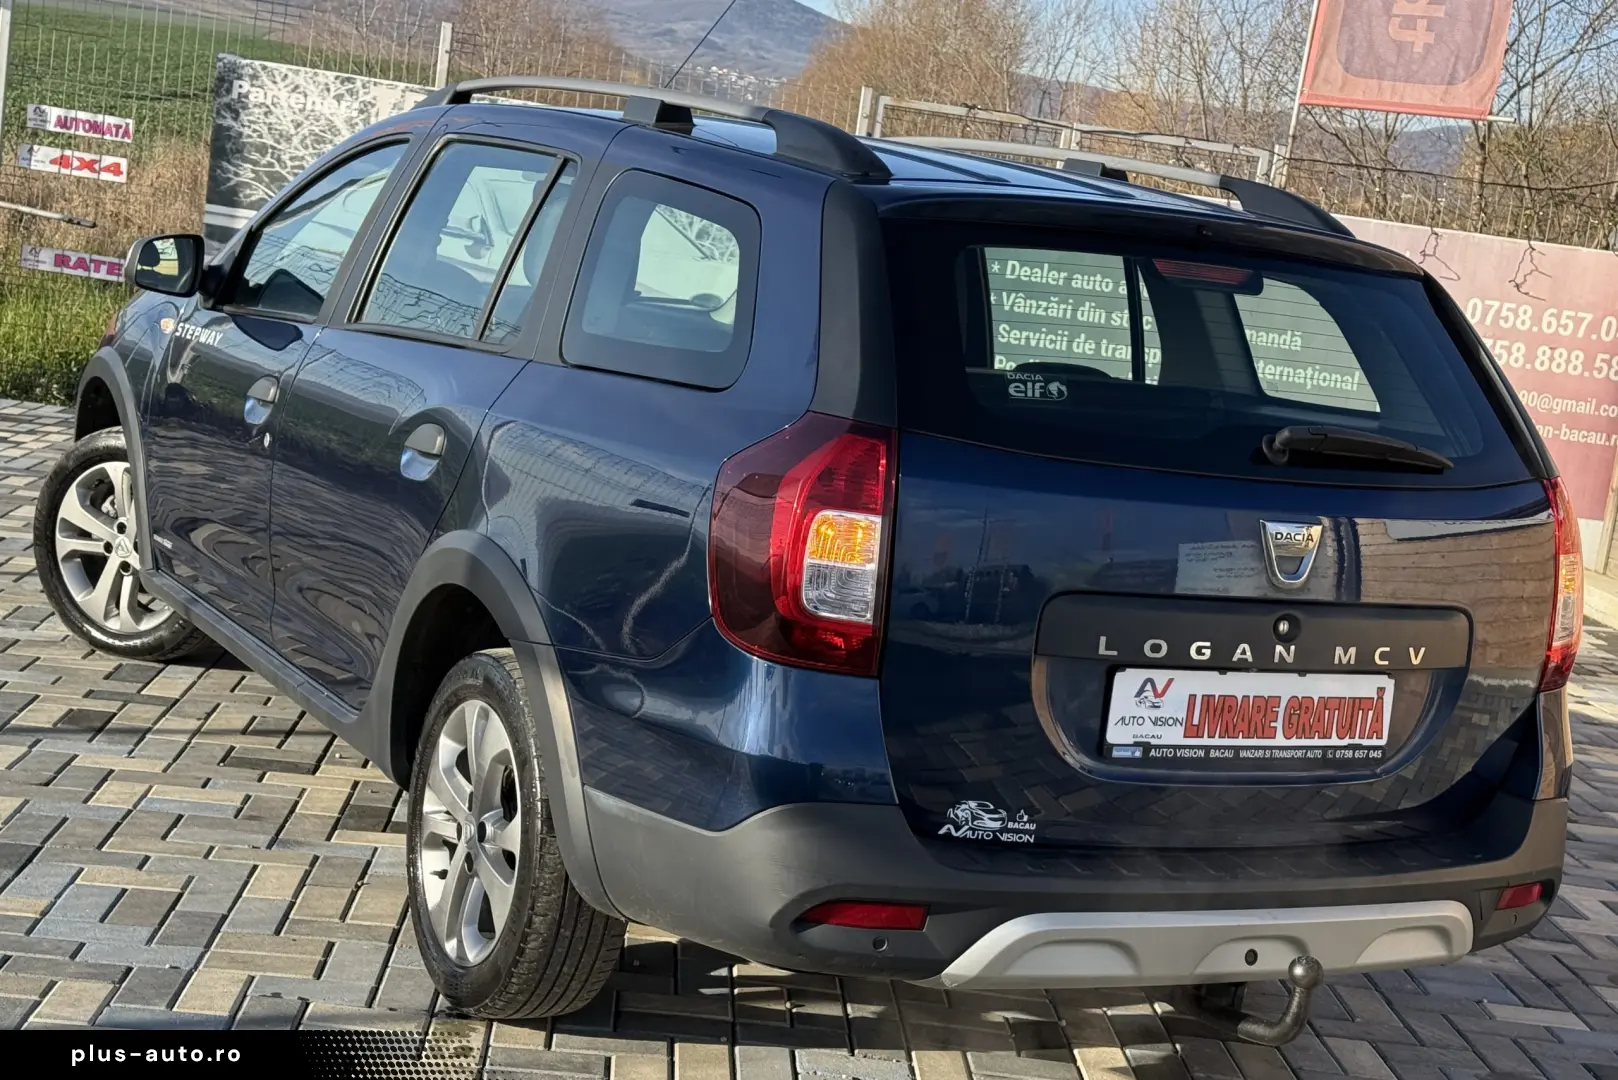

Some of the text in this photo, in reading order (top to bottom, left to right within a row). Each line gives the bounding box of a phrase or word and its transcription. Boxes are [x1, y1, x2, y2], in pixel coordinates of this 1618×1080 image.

[53, 114, 132, 140] AUTOMATĂ
[54, 253, 123, 277] RATE
[1005, 260, 1068, 287] Dealer
[1071, 273, 1114, 293] auto
[1001, 291, 1154, 331] Vânzări din stc
[1465, 297, 1618, 343] 0758.657.0
[174, 321, 224, 347] STEPWAY
[997, 323, 1068, 352] Servicii
[1072, 333, 1096, 355] de
[1006, 372, 1044, 381] DACIA
[1007, 382, 1045, 398] elf
[1519, 389, 1618, 418] 90@gmail.co
[1274, 531, 1315, 543] DACIA
[1097, 635, 1426, 666] LOGAN MCV
[1114, 715, 1185, 728] AUTO VISION
[1183, 686, 1387, 741] LIVRARE GRATUITĂ
[1149, 748, 1383, 759] AUTO VISION BACAU VANZARI SI TRANSPORT AUTO 0758 657 045
[959, 830, 1036, 843] AUTO VISION
[1007, 821, 1037, 830] BACAU
